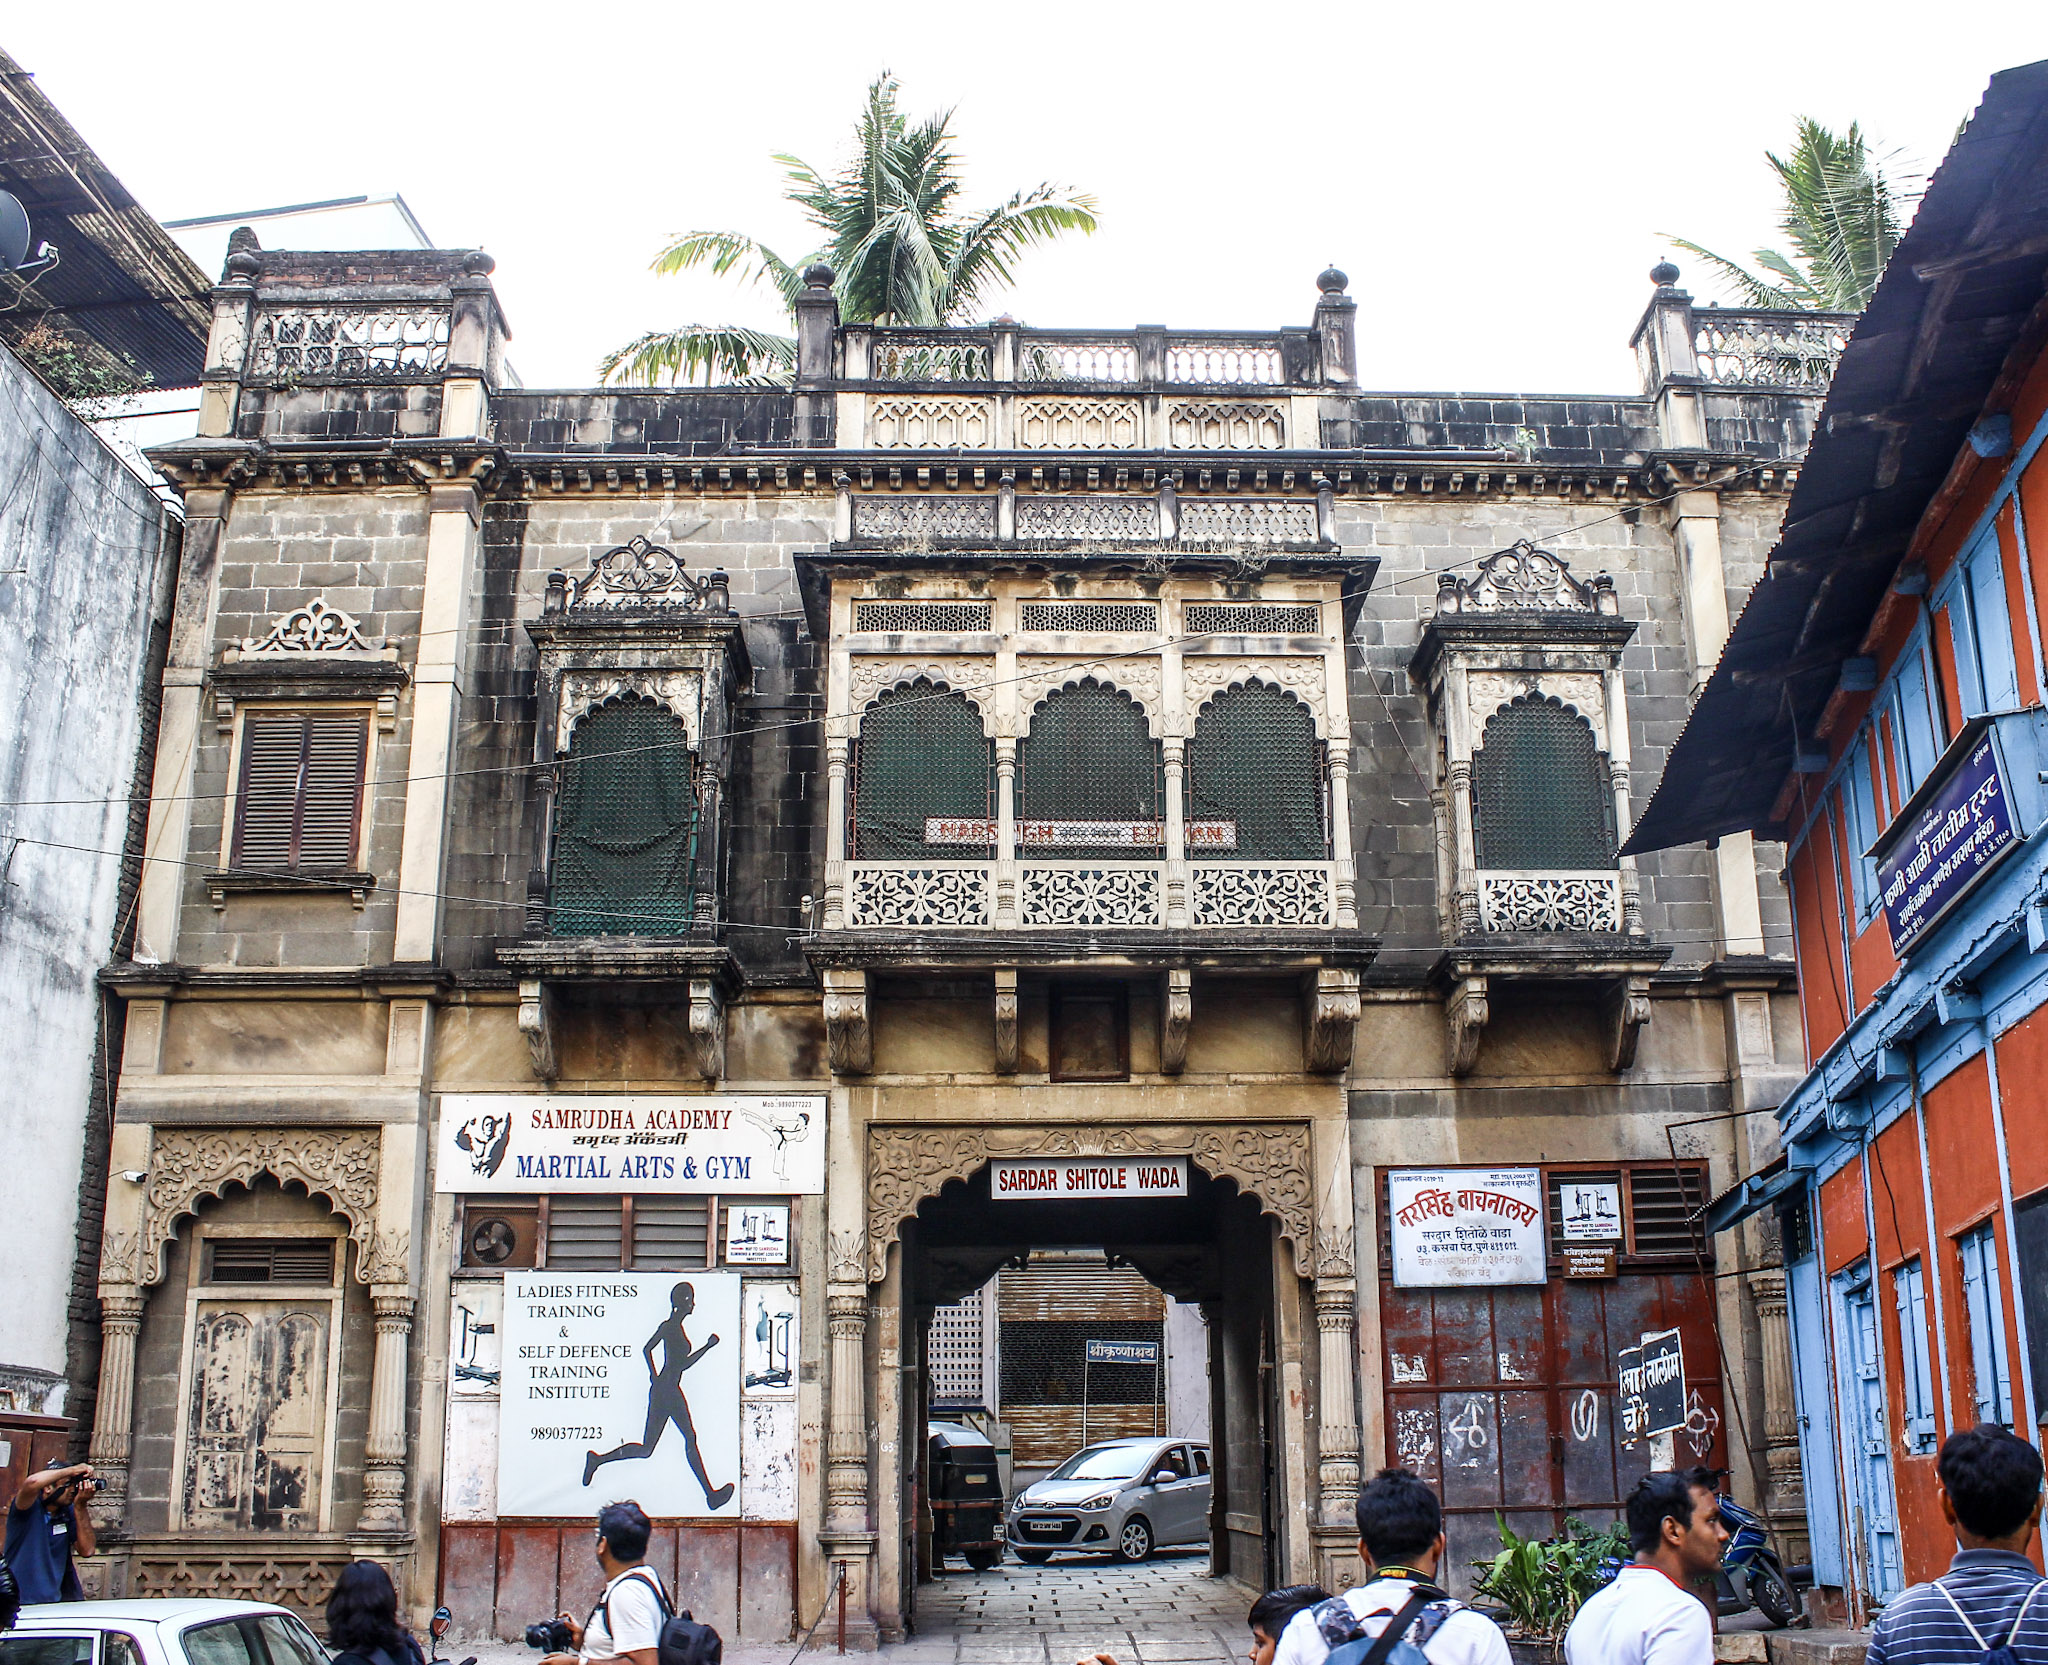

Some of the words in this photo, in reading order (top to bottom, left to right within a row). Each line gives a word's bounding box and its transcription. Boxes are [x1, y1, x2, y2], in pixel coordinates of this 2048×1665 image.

[531, 1109, 635, 1130] SAMRUDHA
[645, 1109, 732, 1130] ACADEMY
[516, 1155, 611, 1179] MARTIAL
[619, 1156, 674, 1179] ARTS
[683, 1157, 697, 1178] &
[705, 1157, 752, 1179] GYM
[999, 1169, 1058, 1191] SARDAR
[1066, 1168, 1127, 1190] SHITOLE
[1137, 1167, 1180, 1189] WADA
[1396, 1188, 1454, 1227] नरसिंह
[1457, 1190, 1539, 1228] वाचनालय
[1422, 1230, 1452, 1242] सरदार
[1455, 1225, 1488, 1240] शितोळे
[1490, 1228, 1511, 1239] वाडा
[517, 1285, 571, 1298] LADIES
[577, 1284, 638, 1297] FITNESS
[527, 1305, 605, 1318] TRAINING
[559, 1325, 569, 1338] &
[519, 1345, 555, 1358] SELF
[559, 1345, 632, 1358] DEFENCE
[529, 1365, 608, 1379] TRAINING
[1645, 1347, 1680, 1389] तालीम
[528, 1386, 609, 1399] INSTITUTE
[530, 1426, 603, 1440] 9890377223
